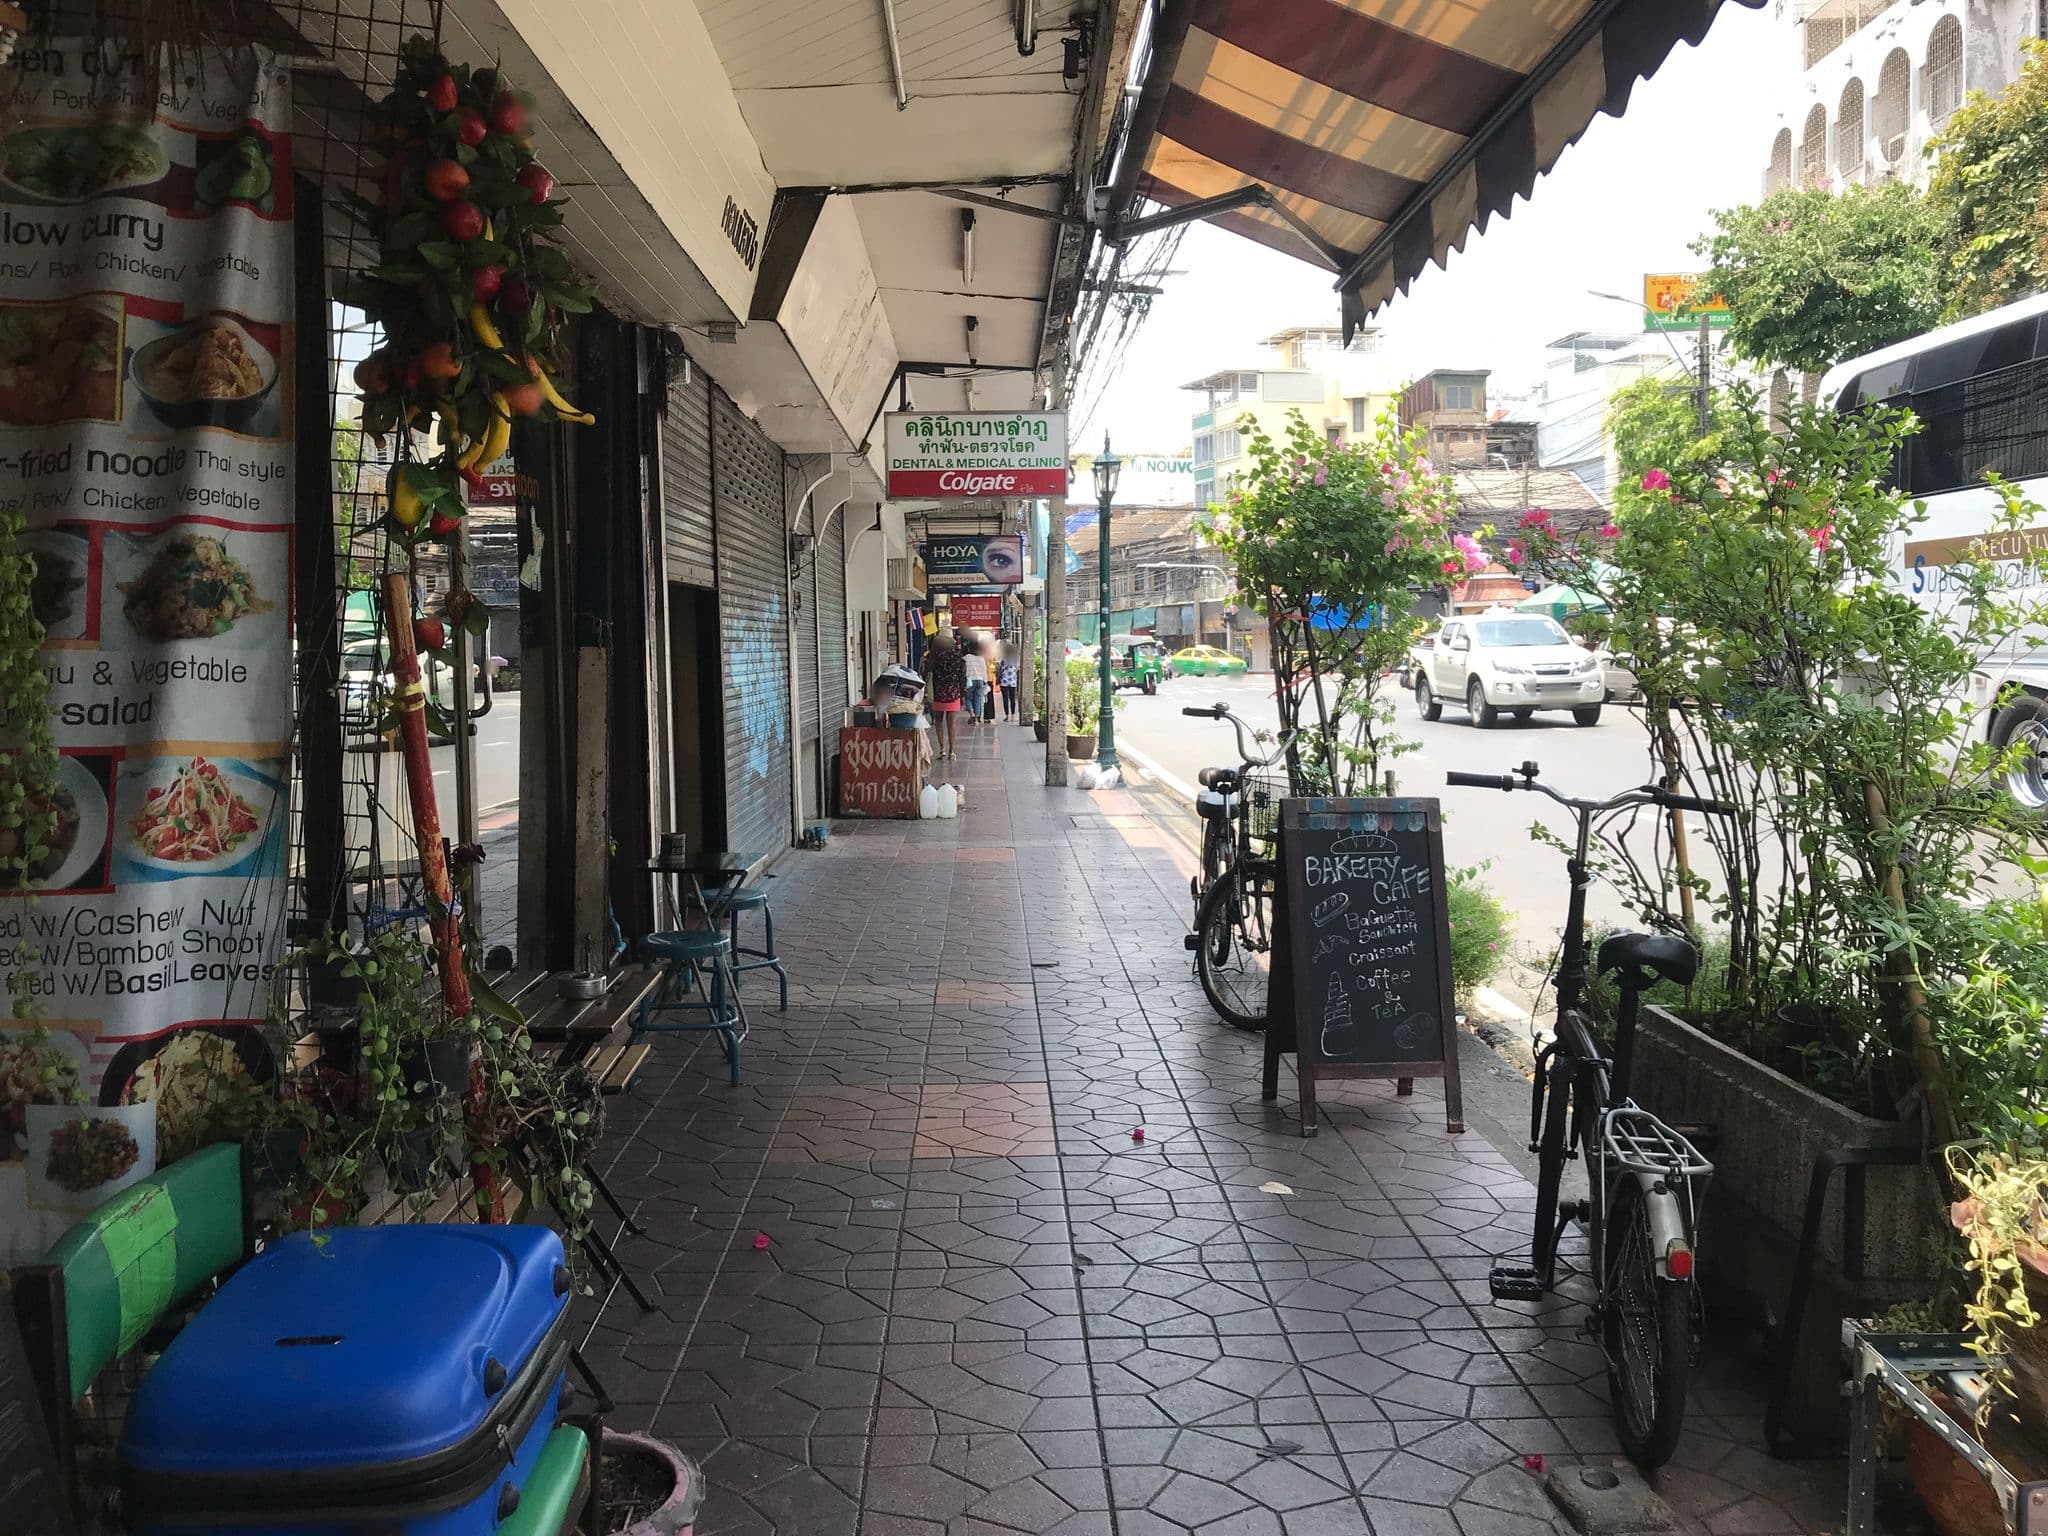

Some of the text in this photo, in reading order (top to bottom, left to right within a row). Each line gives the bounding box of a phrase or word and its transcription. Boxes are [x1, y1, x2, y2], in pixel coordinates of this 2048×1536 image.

[11, 50, 64, 76] en
[81, 213, 165, 252] curry
[198, 251, 260, 282] etable
[905, 415, 1048, 441] คลินิกบางลำภู
[86, 446, 187, 478] noodle
[195, 450, 232, 473] Thai
[238, 461, 286, 482] style
[892, 457, 1062, 469] DENTAL & MEDICAL CLINIC
[939, 472, 1016, 495] Colgate
[176, 484, 261, 512] Vegetable
[932, 545, 979, 558] HOYA
[92, 661, 113, 686] &
[131, 655, 248, 686] Vegetable
[60, 696, 153, 726] salad
[1305, 855, 1401, 887] BAKERY
[1373, 864, 1431, 905] CAFE
[201, 899, 256, 926] Nut
[182, 929, 264, 954] Shoot
[1356, 968, 1411, 990] Coffee
